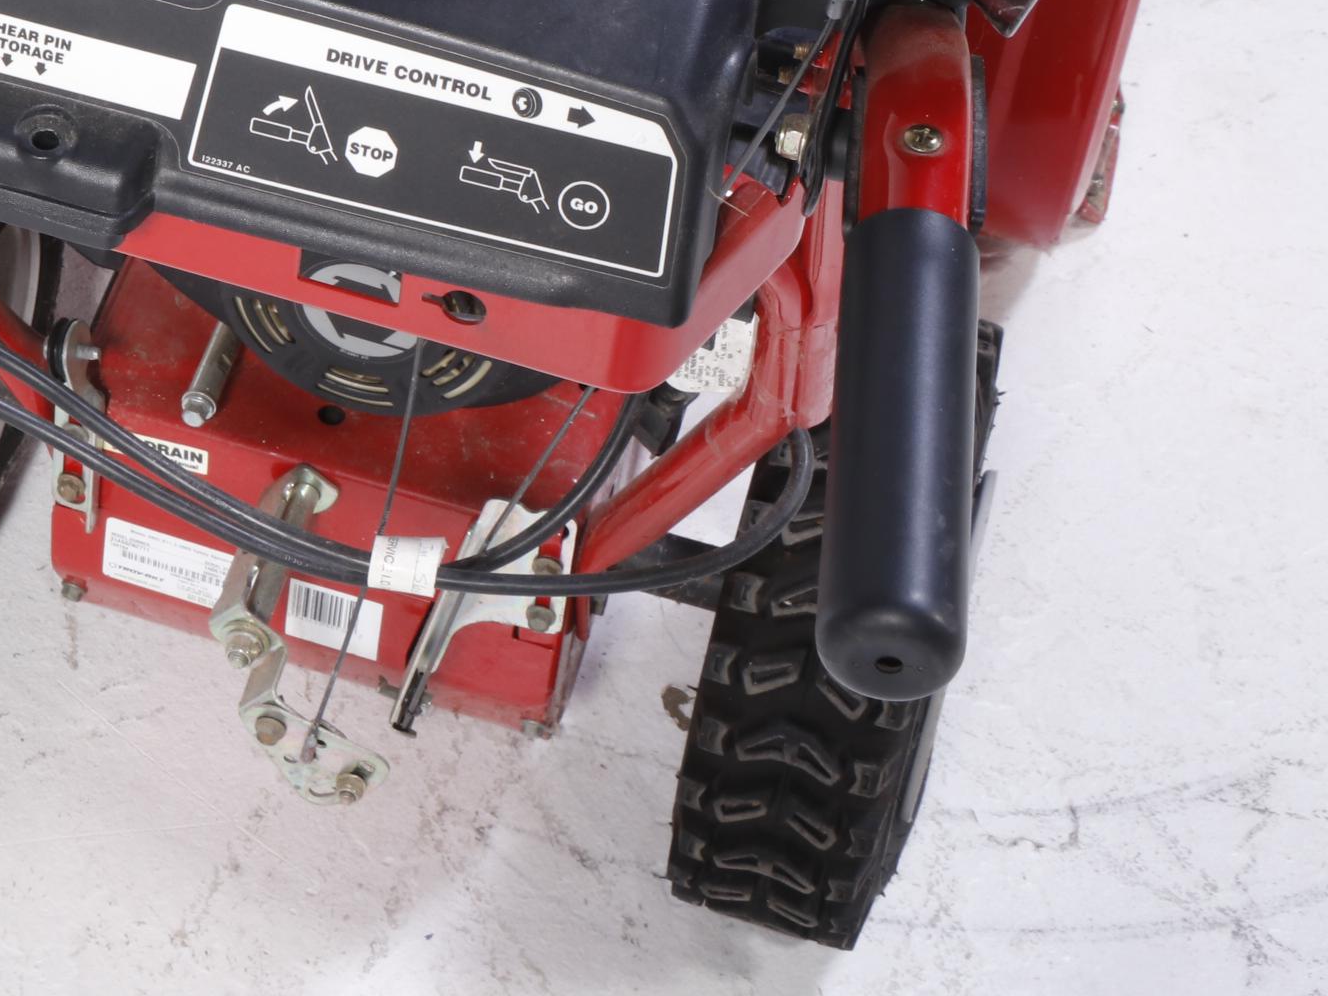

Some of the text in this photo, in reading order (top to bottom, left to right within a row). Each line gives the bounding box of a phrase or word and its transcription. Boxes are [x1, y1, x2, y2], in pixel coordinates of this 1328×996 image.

[44, 34, 71, 51] PIN
[326, 48, 491, 101] DRIVE CONTROL
[349, 142, 393, 161] STOP
[235, 164, 250, 173] AC
[570, 197, 598, 213] GO
